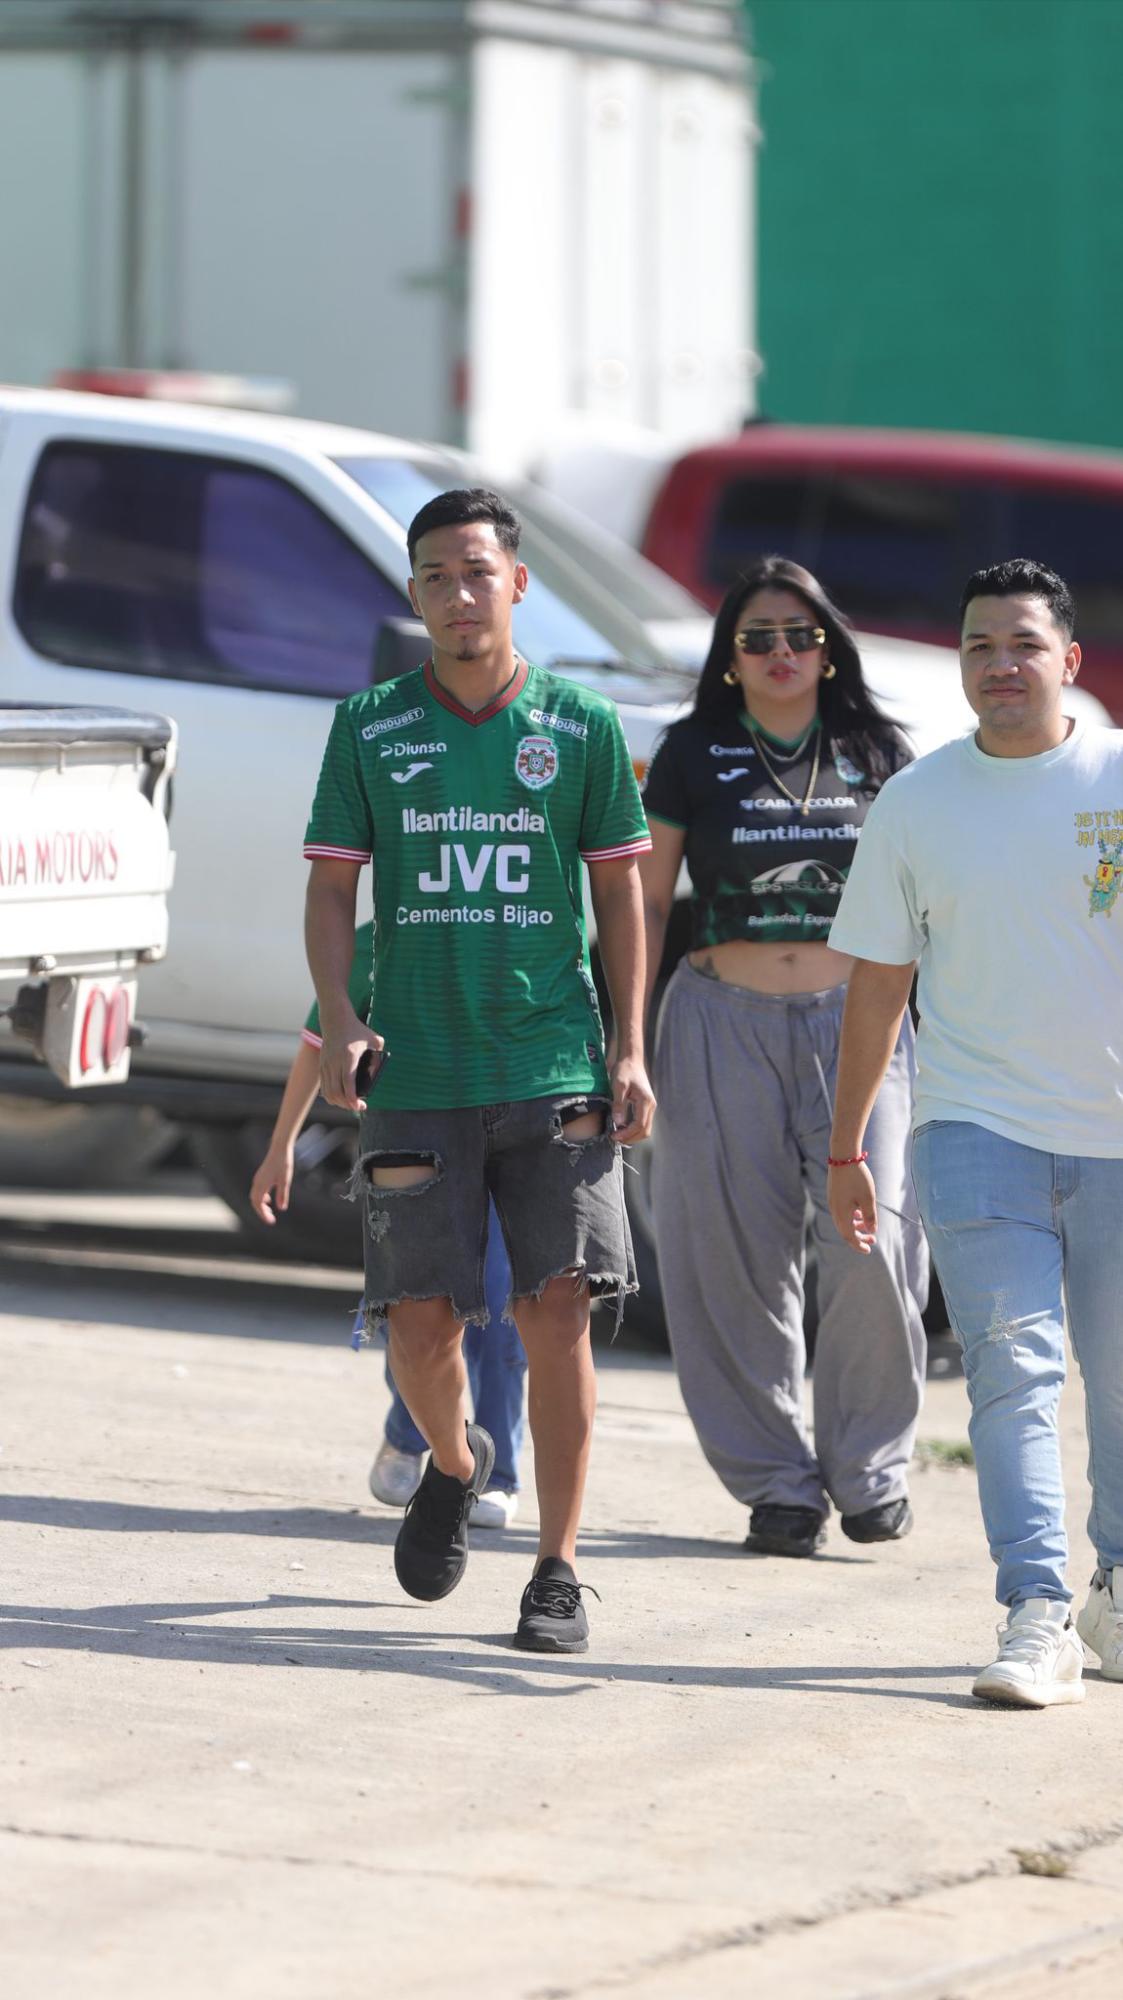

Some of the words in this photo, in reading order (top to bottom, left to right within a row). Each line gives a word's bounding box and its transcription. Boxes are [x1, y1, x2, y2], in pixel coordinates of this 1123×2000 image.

[364, 709, 421, 738] HONDUBET
[532, 711, 588, 737] HONDUBET
[394, 742, 447, 757] Diunsa
[806, 797, 857, 808] COLOR
[402, 806, 545, 834] llantilandia
[35, 831, 118, 884] MOTORS
[418, 844, 531, 893] JVC
[396, 905, 496, 925] Cementos
[503, 905, 554, 928] Bijao
